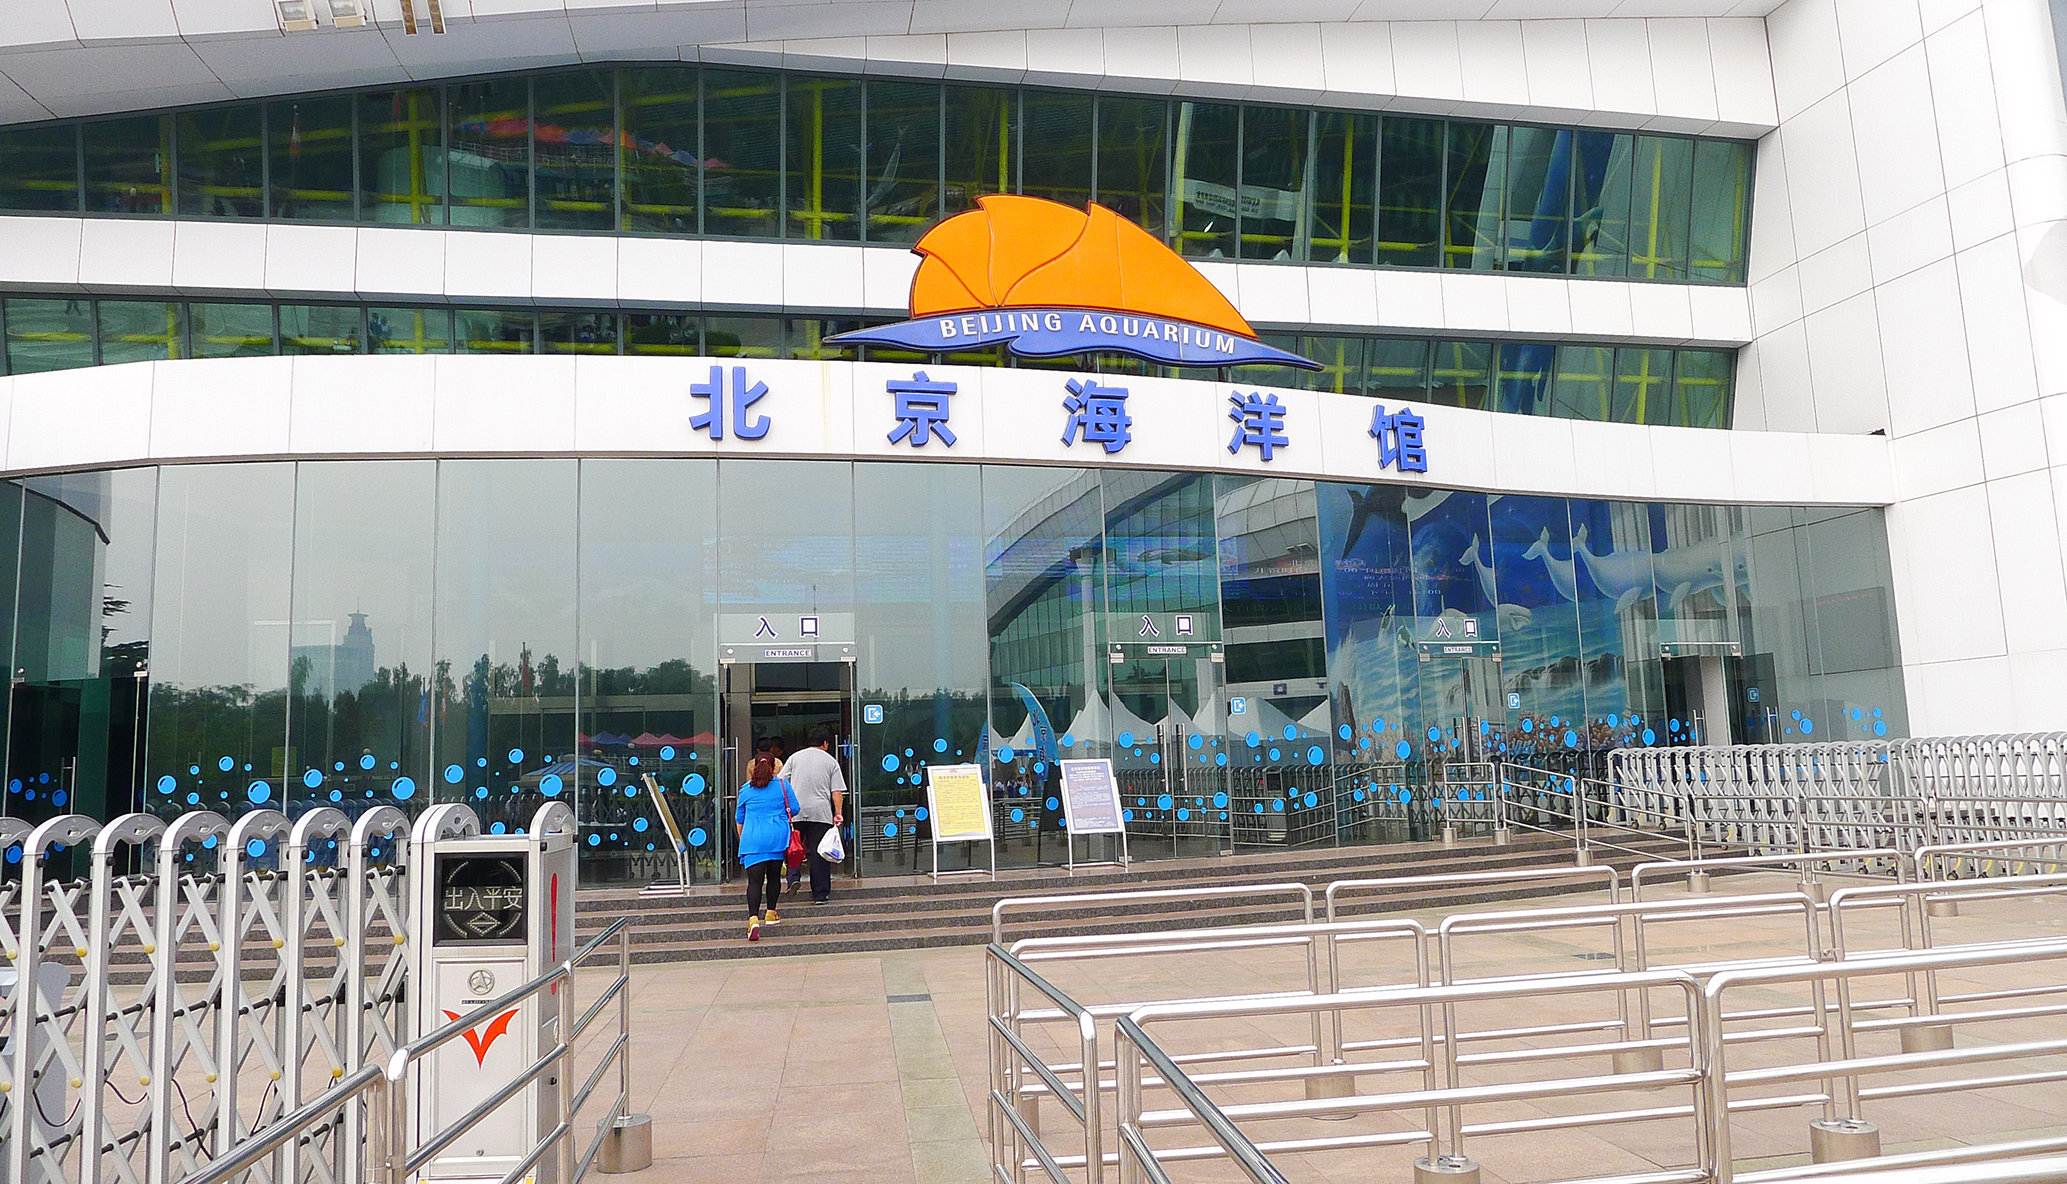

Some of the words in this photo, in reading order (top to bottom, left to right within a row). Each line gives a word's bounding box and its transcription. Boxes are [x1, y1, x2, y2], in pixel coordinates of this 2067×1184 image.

[939, 312, 1062, 338] BEIJING
[1078, 314, 1236, 355] AQUARIUM
[689, 365, 1428, 473] 北京海洋馆
[753, 615, 819, 639] 入口
[1139, 614, 1193, 637] 入口
[1436, 618, 1477, 638] 入口
[444, 886, 523, 911] 出入平安
